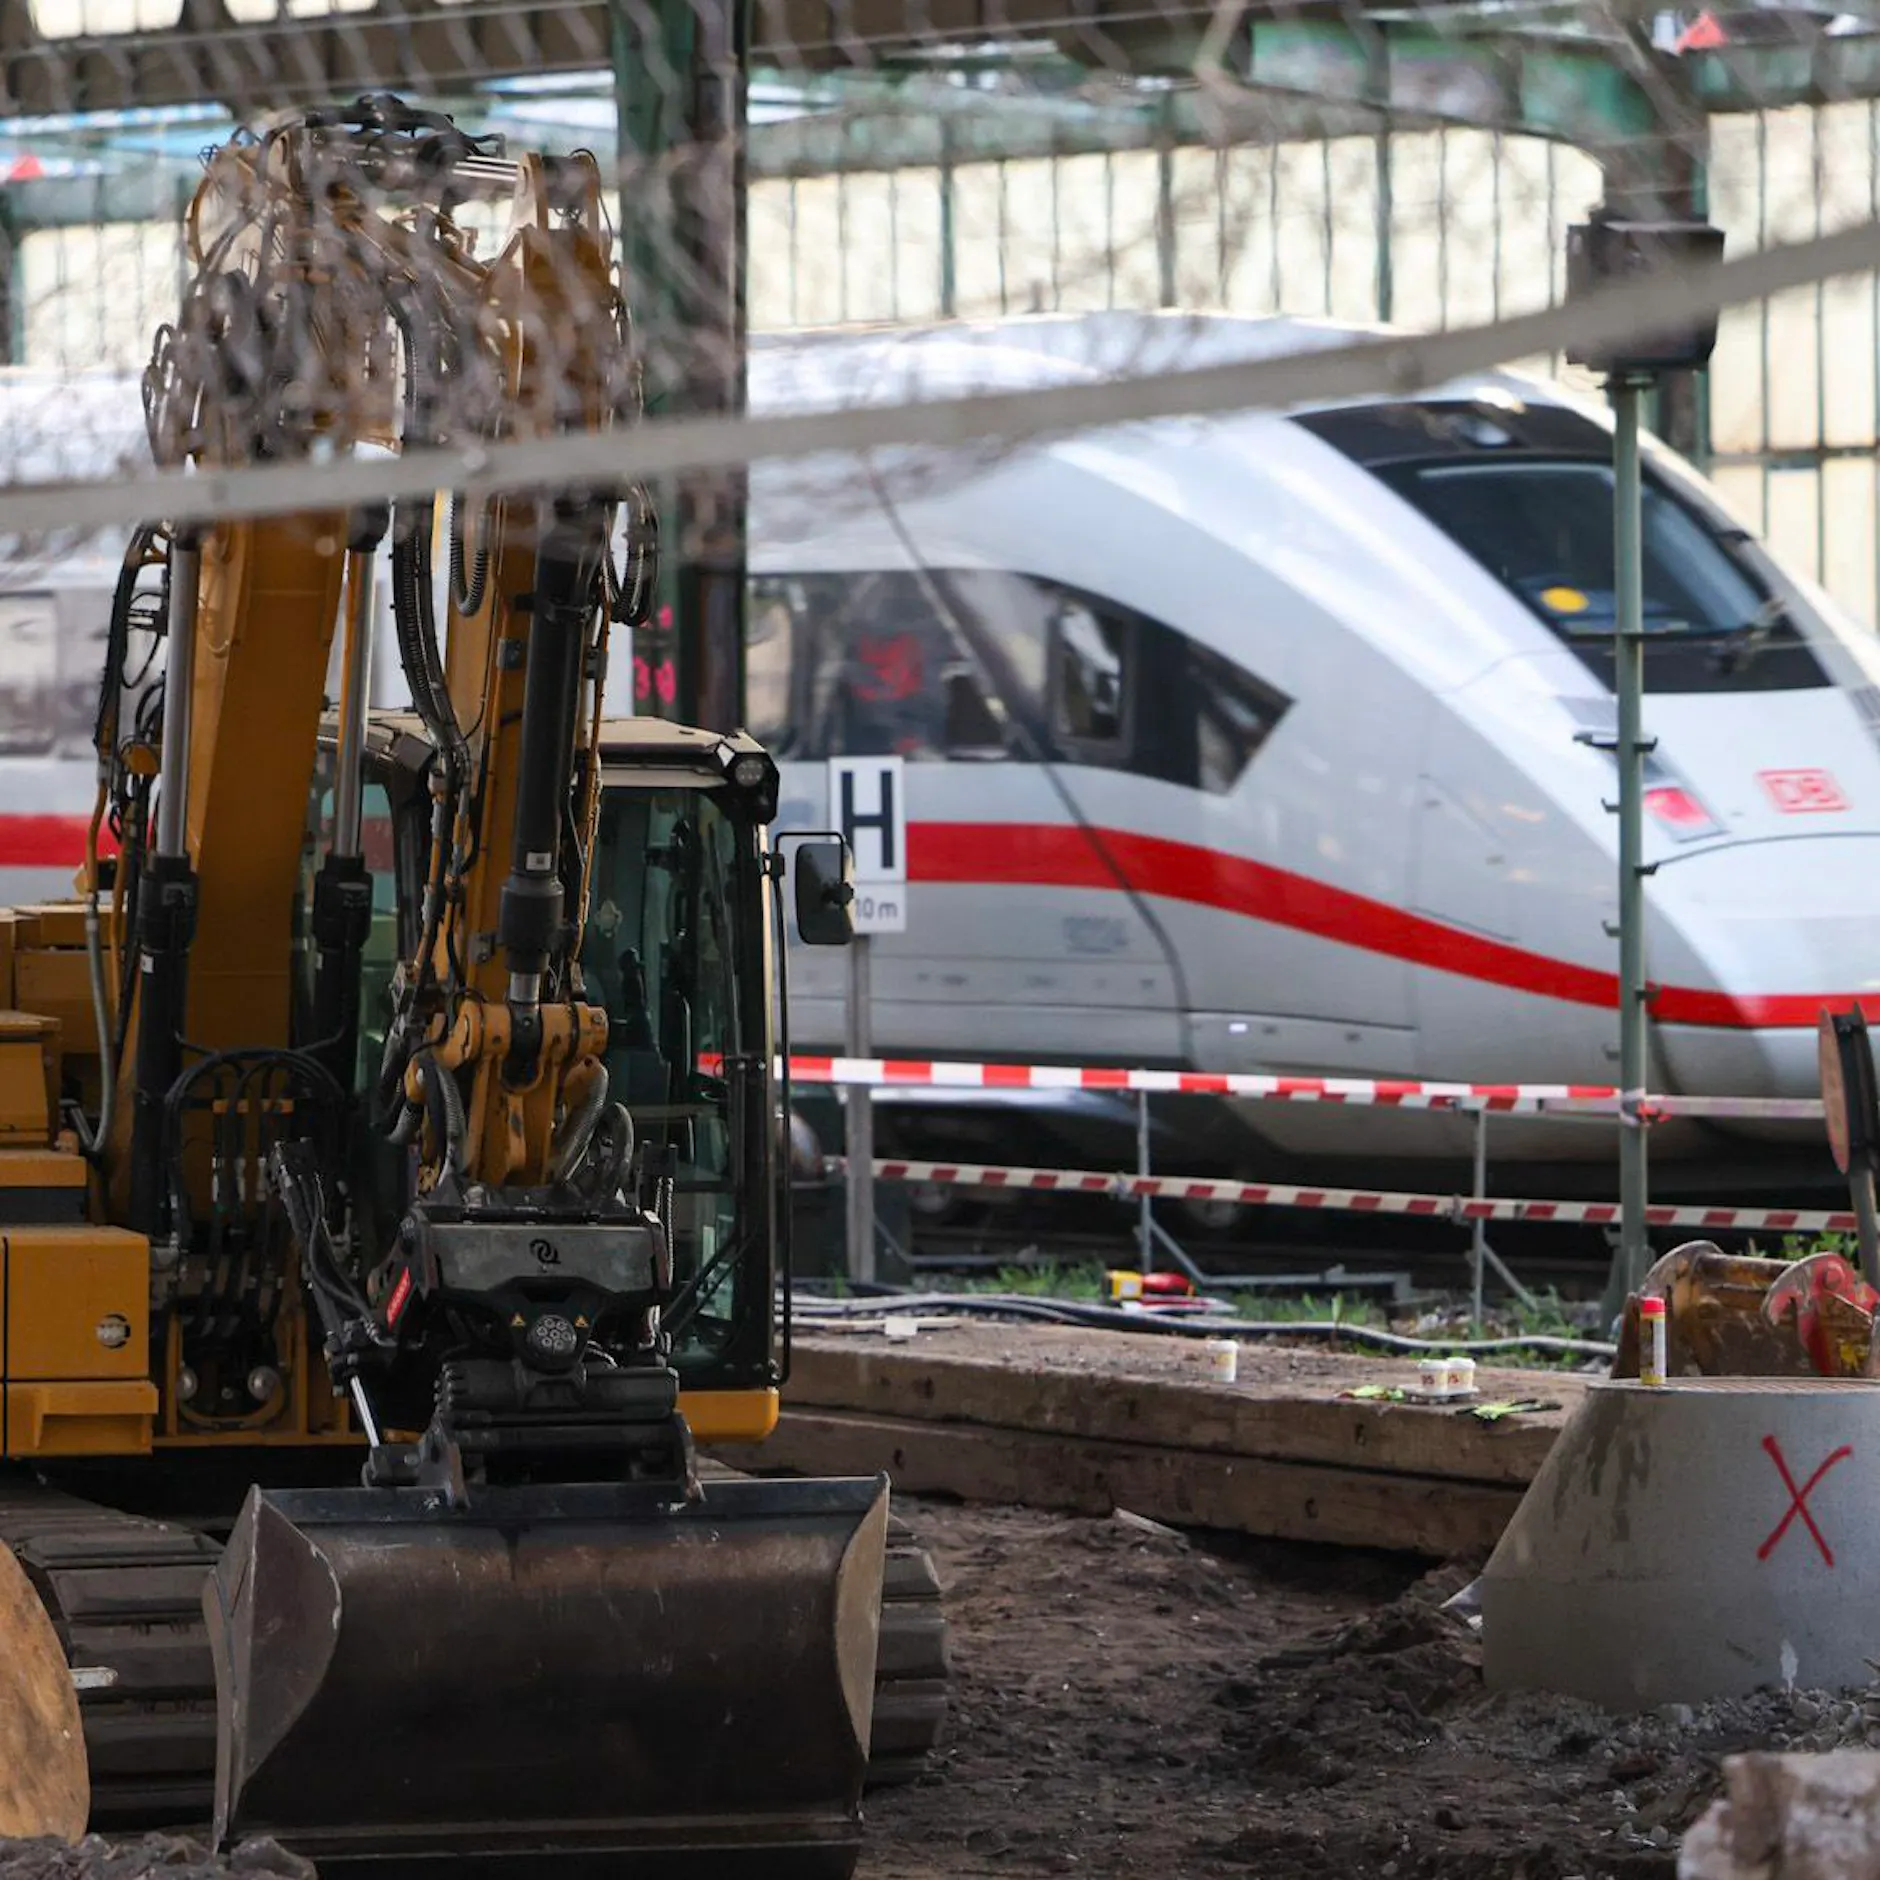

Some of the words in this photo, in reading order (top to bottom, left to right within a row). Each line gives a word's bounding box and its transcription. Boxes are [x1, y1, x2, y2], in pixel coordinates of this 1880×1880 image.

[1763, 775, 1842, 806] DB
[841, 770, 894, 869] H
[878, 902, 898, 918] m
